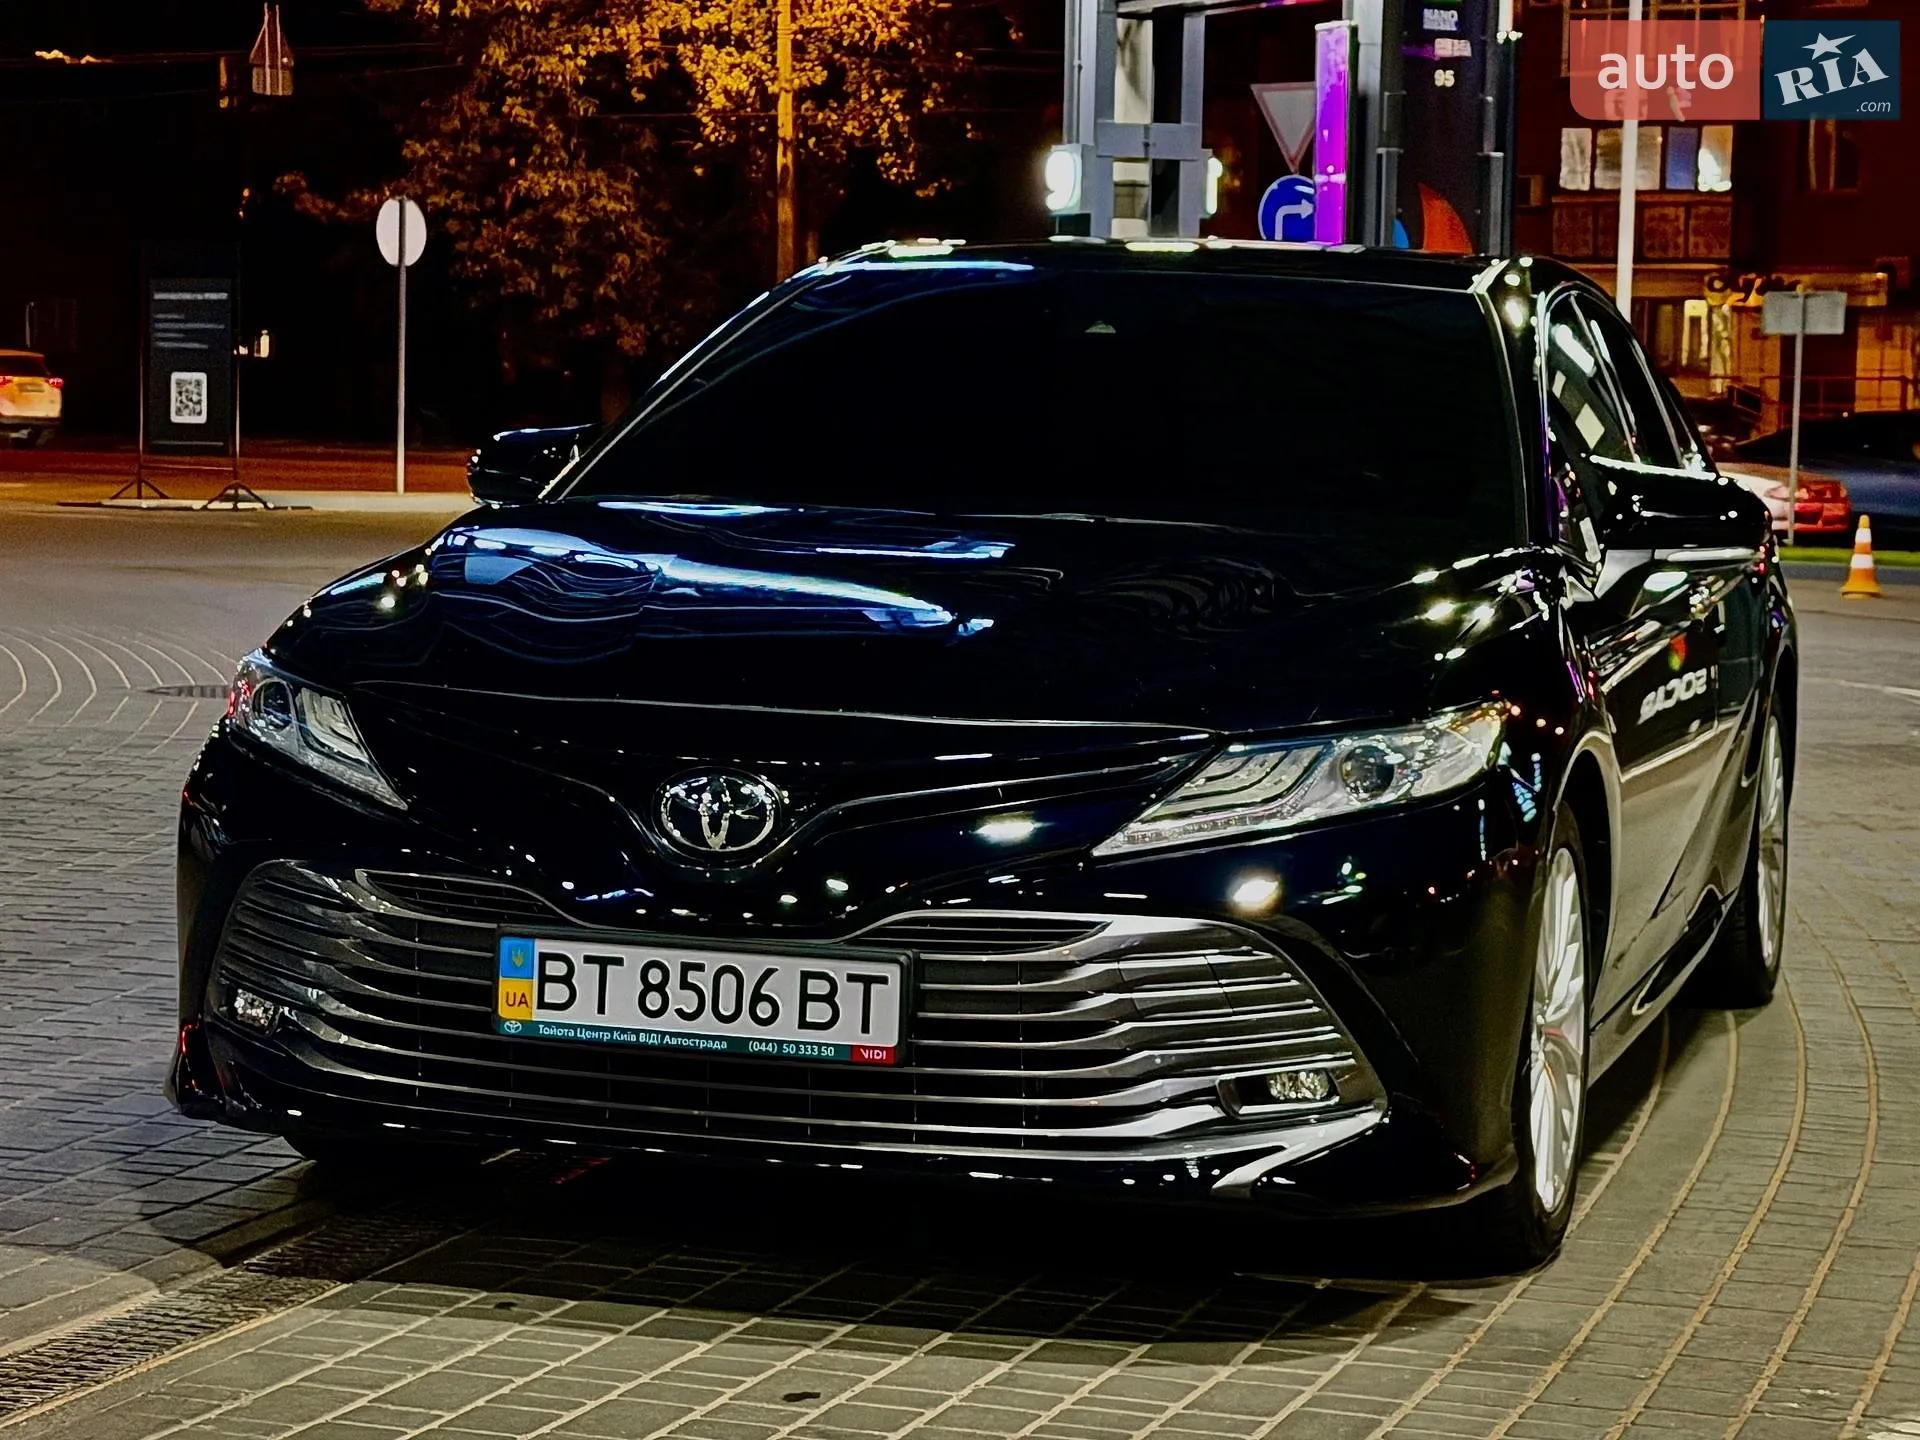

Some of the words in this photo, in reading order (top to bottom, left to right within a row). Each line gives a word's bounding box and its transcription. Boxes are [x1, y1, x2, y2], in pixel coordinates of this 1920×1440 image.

[1434, 69, 1455, 87] 95
[505, 992, 529, 1008] UA
[537, 951, 625, 1016] BT
[637, 959, 780, 1027] 8506
[797, 969, 889, 1035] BT
[538, 1024, 575, 1037] Тойота
[576, 1029, 611, 1041] Центр
[613, 1030, 637, 1042] Київ
[662, 1035, 727, 1049] Автострада
[748, 1041, 778, 1053] (044)
[782, 1043, 796, 1055] 50
[798, 1044, 819, 1056] 333
[820, 1045, 835, 1056] 50
[860, 1048, 887, 1060] VIDI
